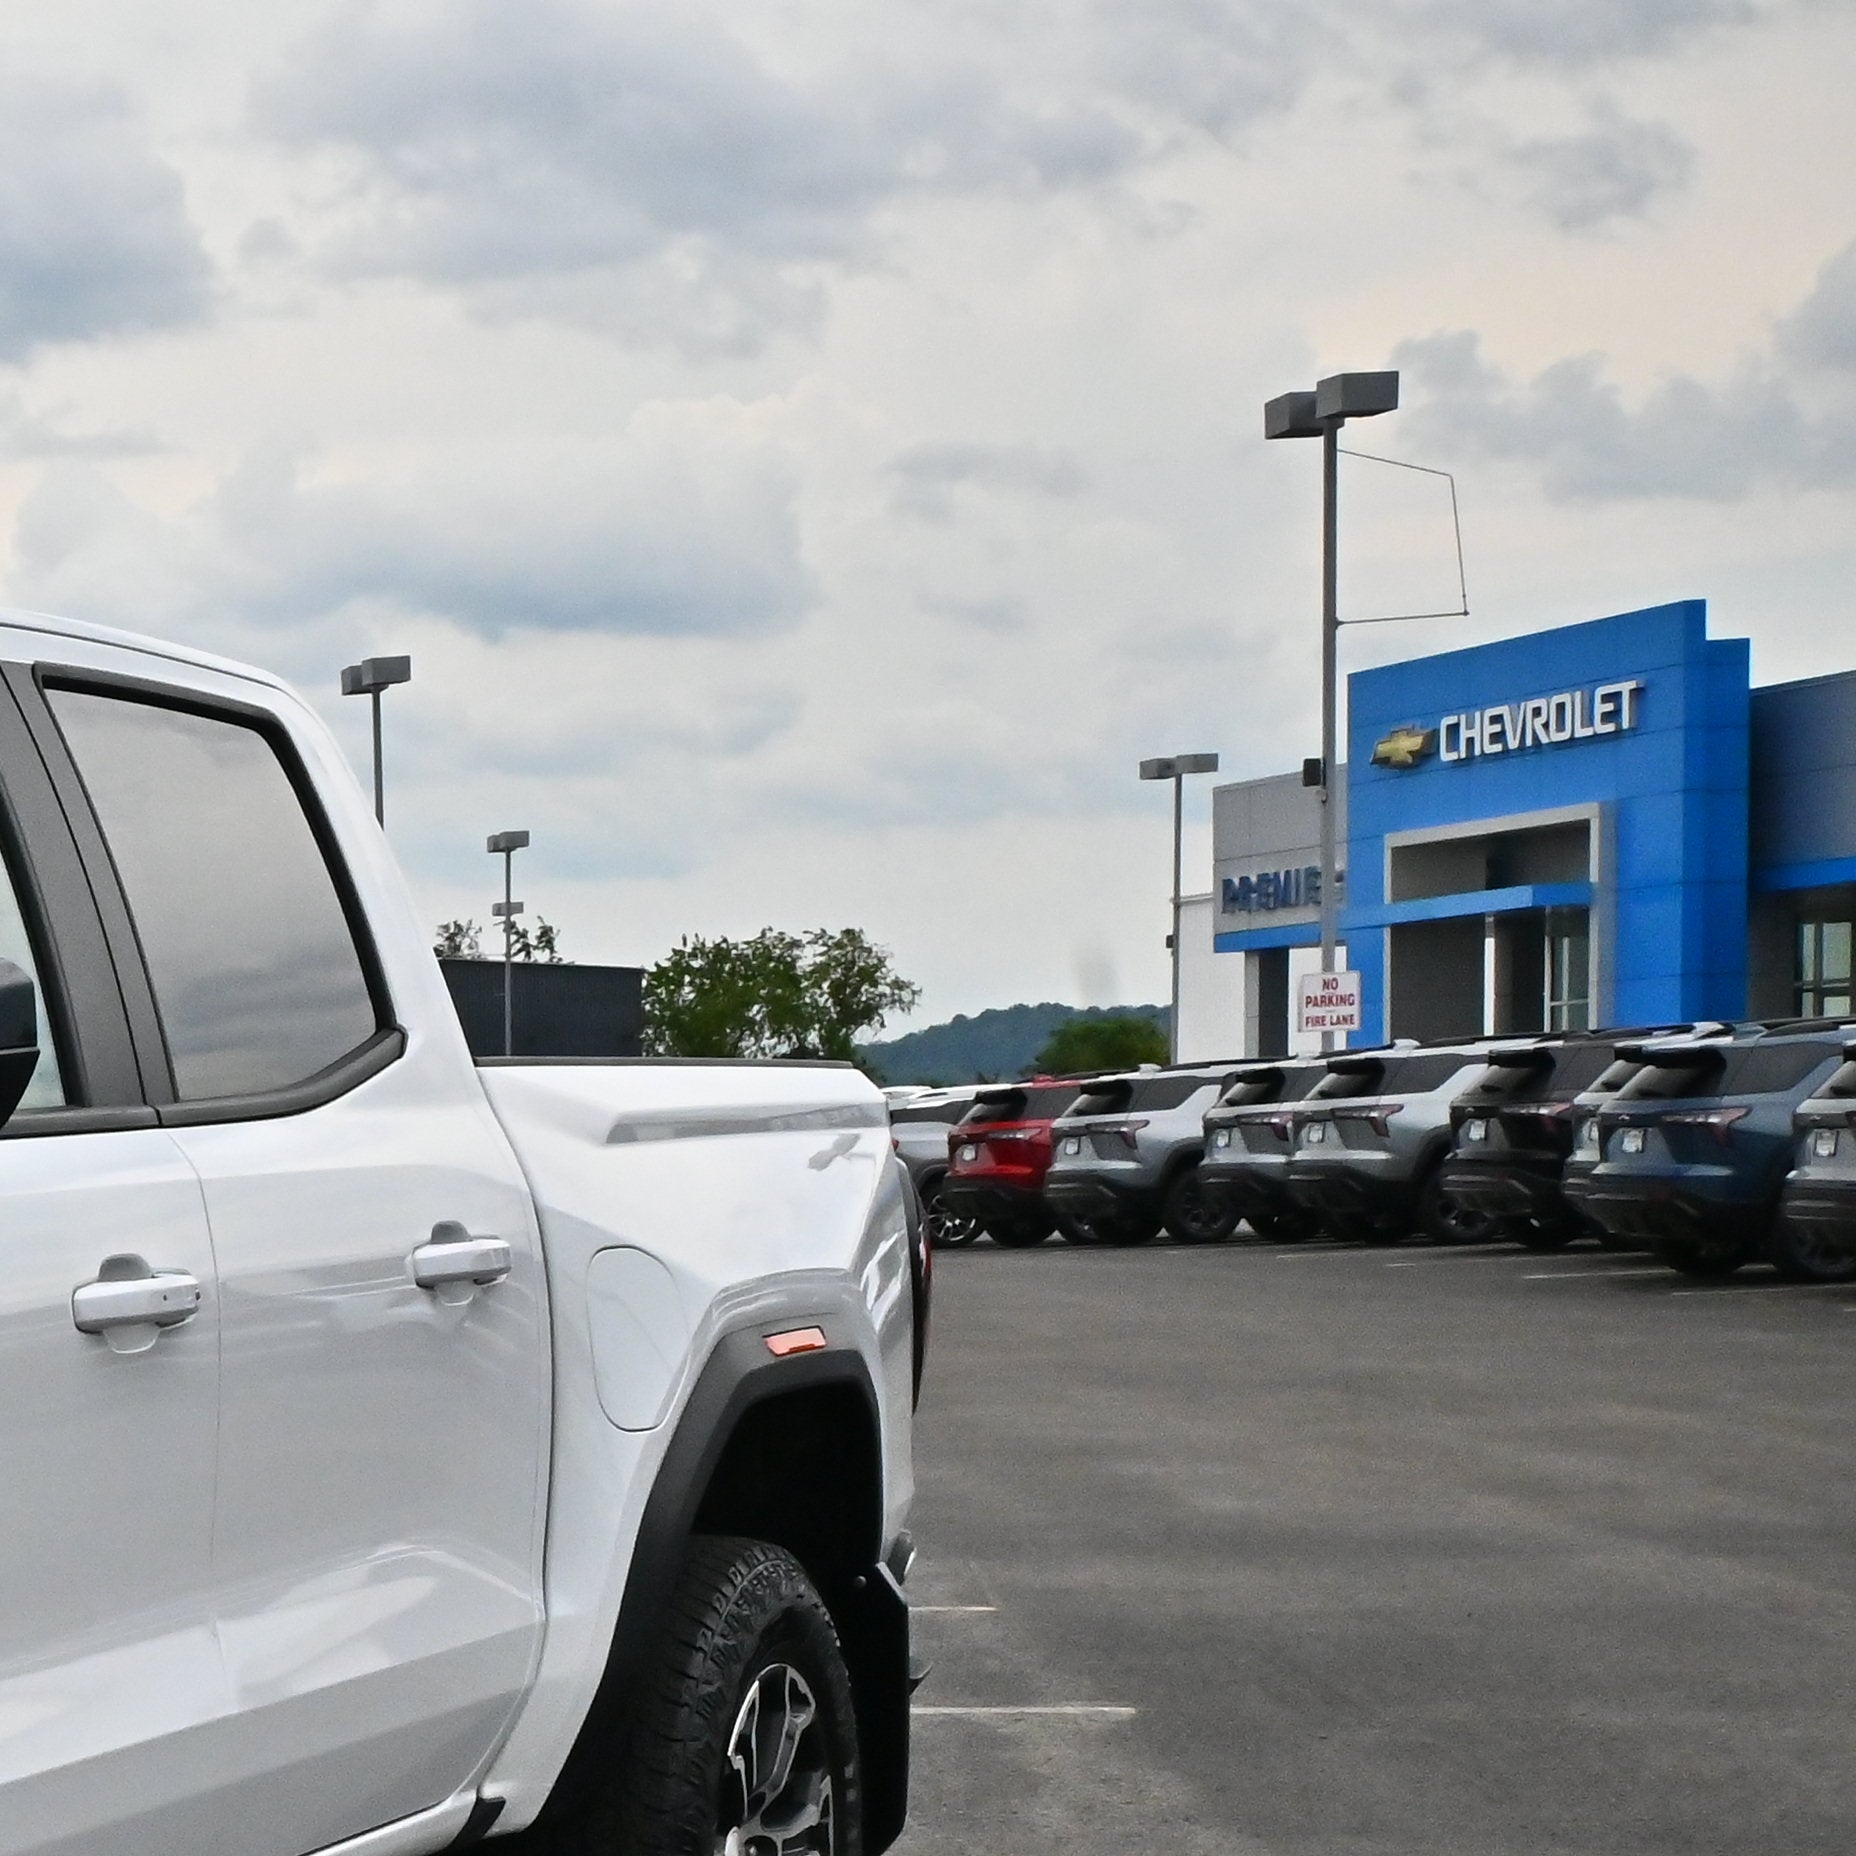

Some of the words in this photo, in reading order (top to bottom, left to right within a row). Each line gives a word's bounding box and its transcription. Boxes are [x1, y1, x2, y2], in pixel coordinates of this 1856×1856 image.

[1440, 679, 1639, 763] CHEVROLET
[1322, 977, 1339, 991] NO
[1305, 993, 1355, 1009] PARKING
[1305, 1014, 1327, 1028] FIRE
[1329, 1013, 1355, 1027] LANE
